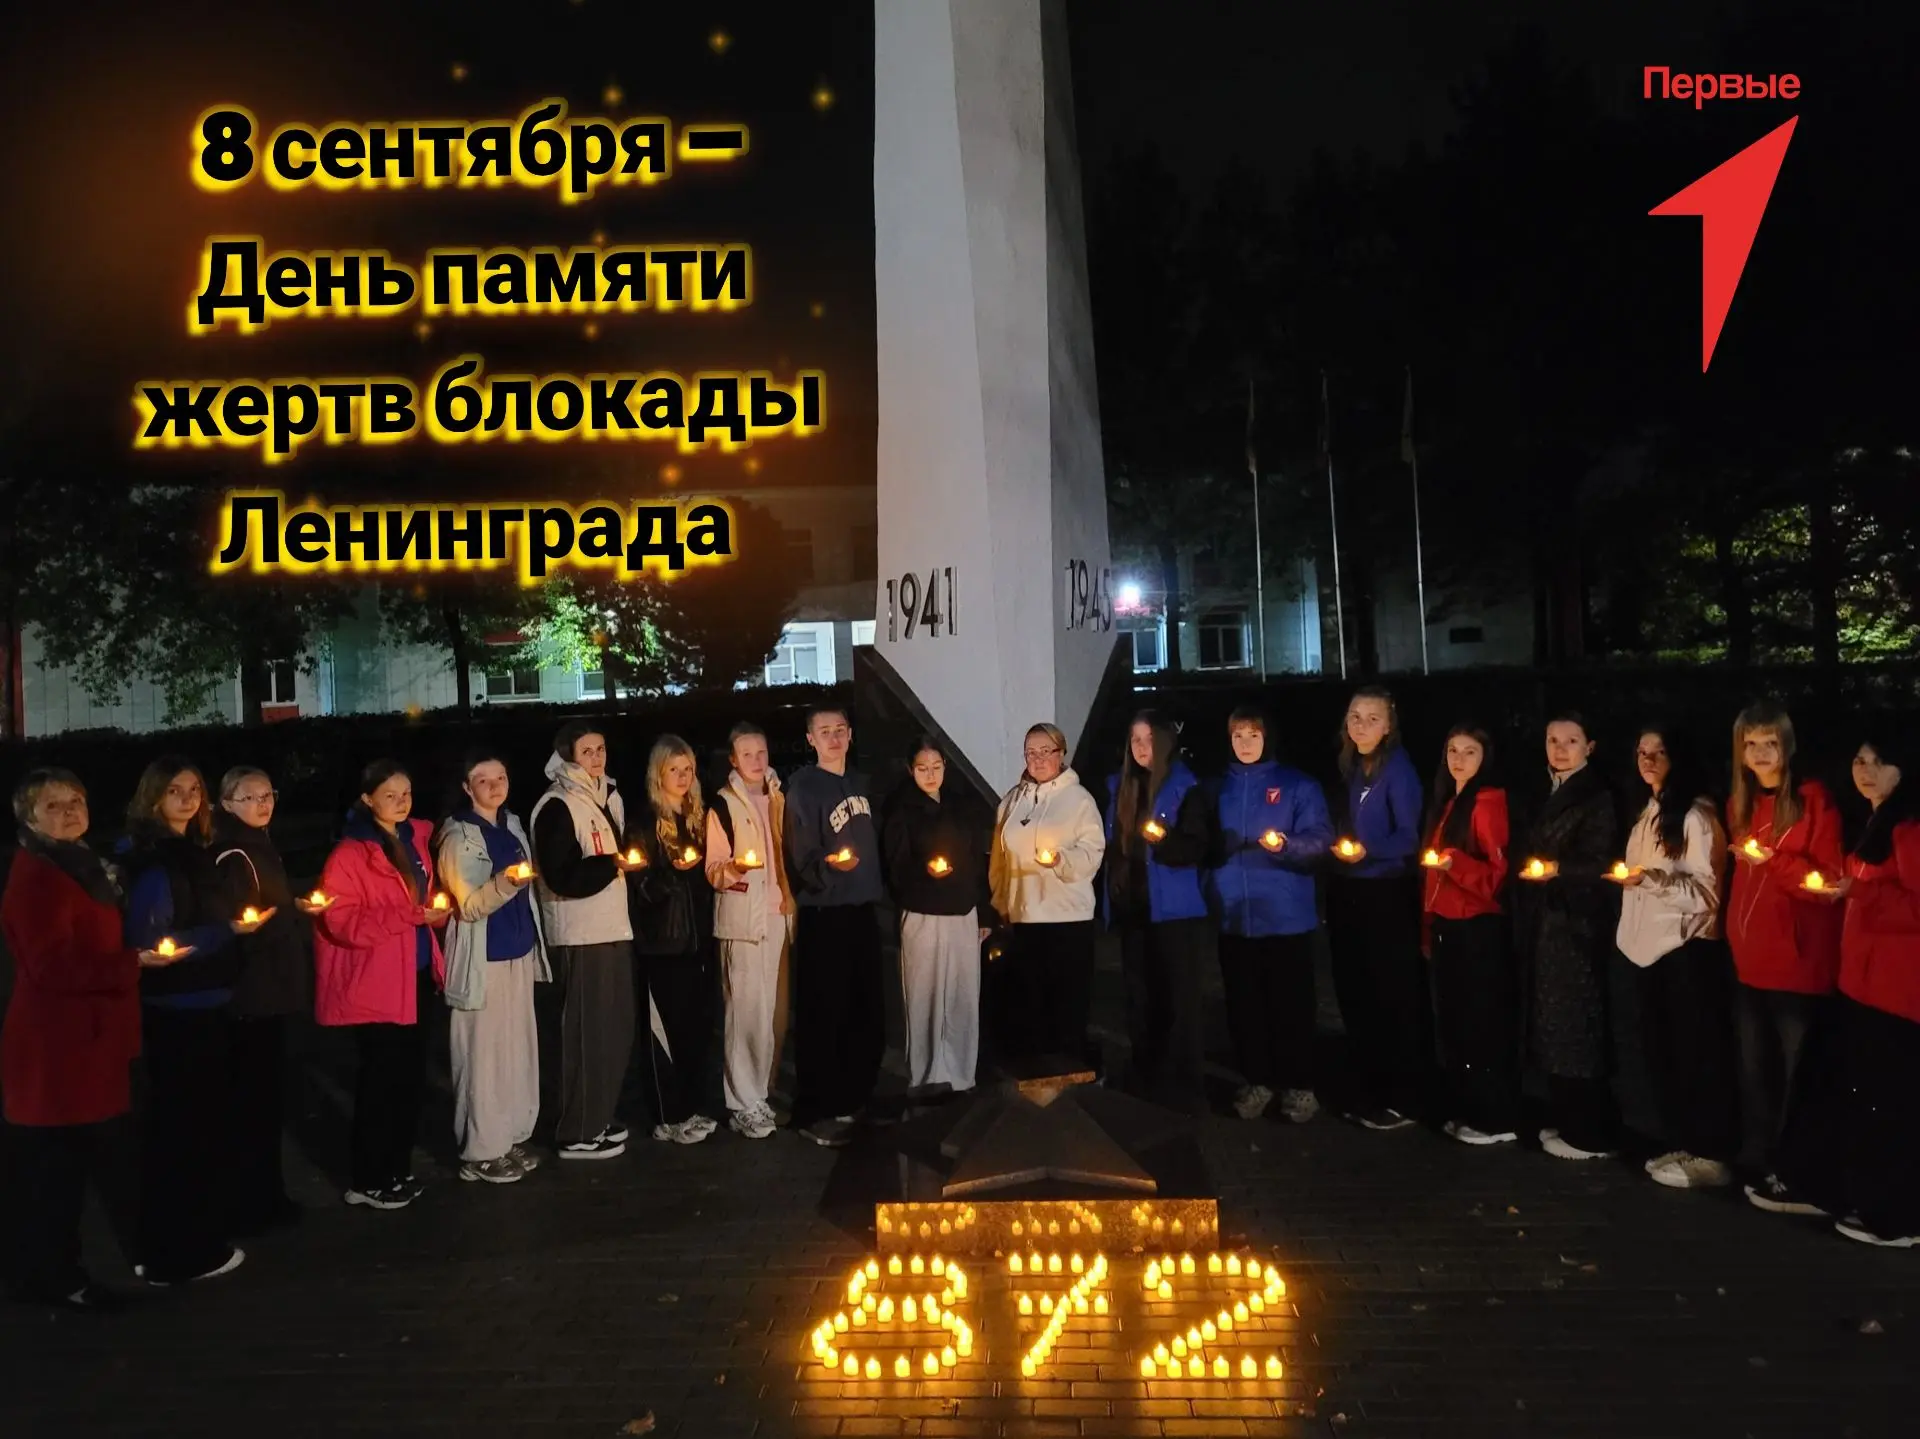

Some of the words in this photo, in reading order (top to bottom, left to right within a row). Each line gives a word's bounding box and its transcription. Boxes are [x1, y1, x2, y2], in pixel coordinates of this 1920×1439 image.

[886, 566, 958, 642] 1941
[1065, 558, 1111, 633] 1945
[811, 1252, 1286, 1380] 872
